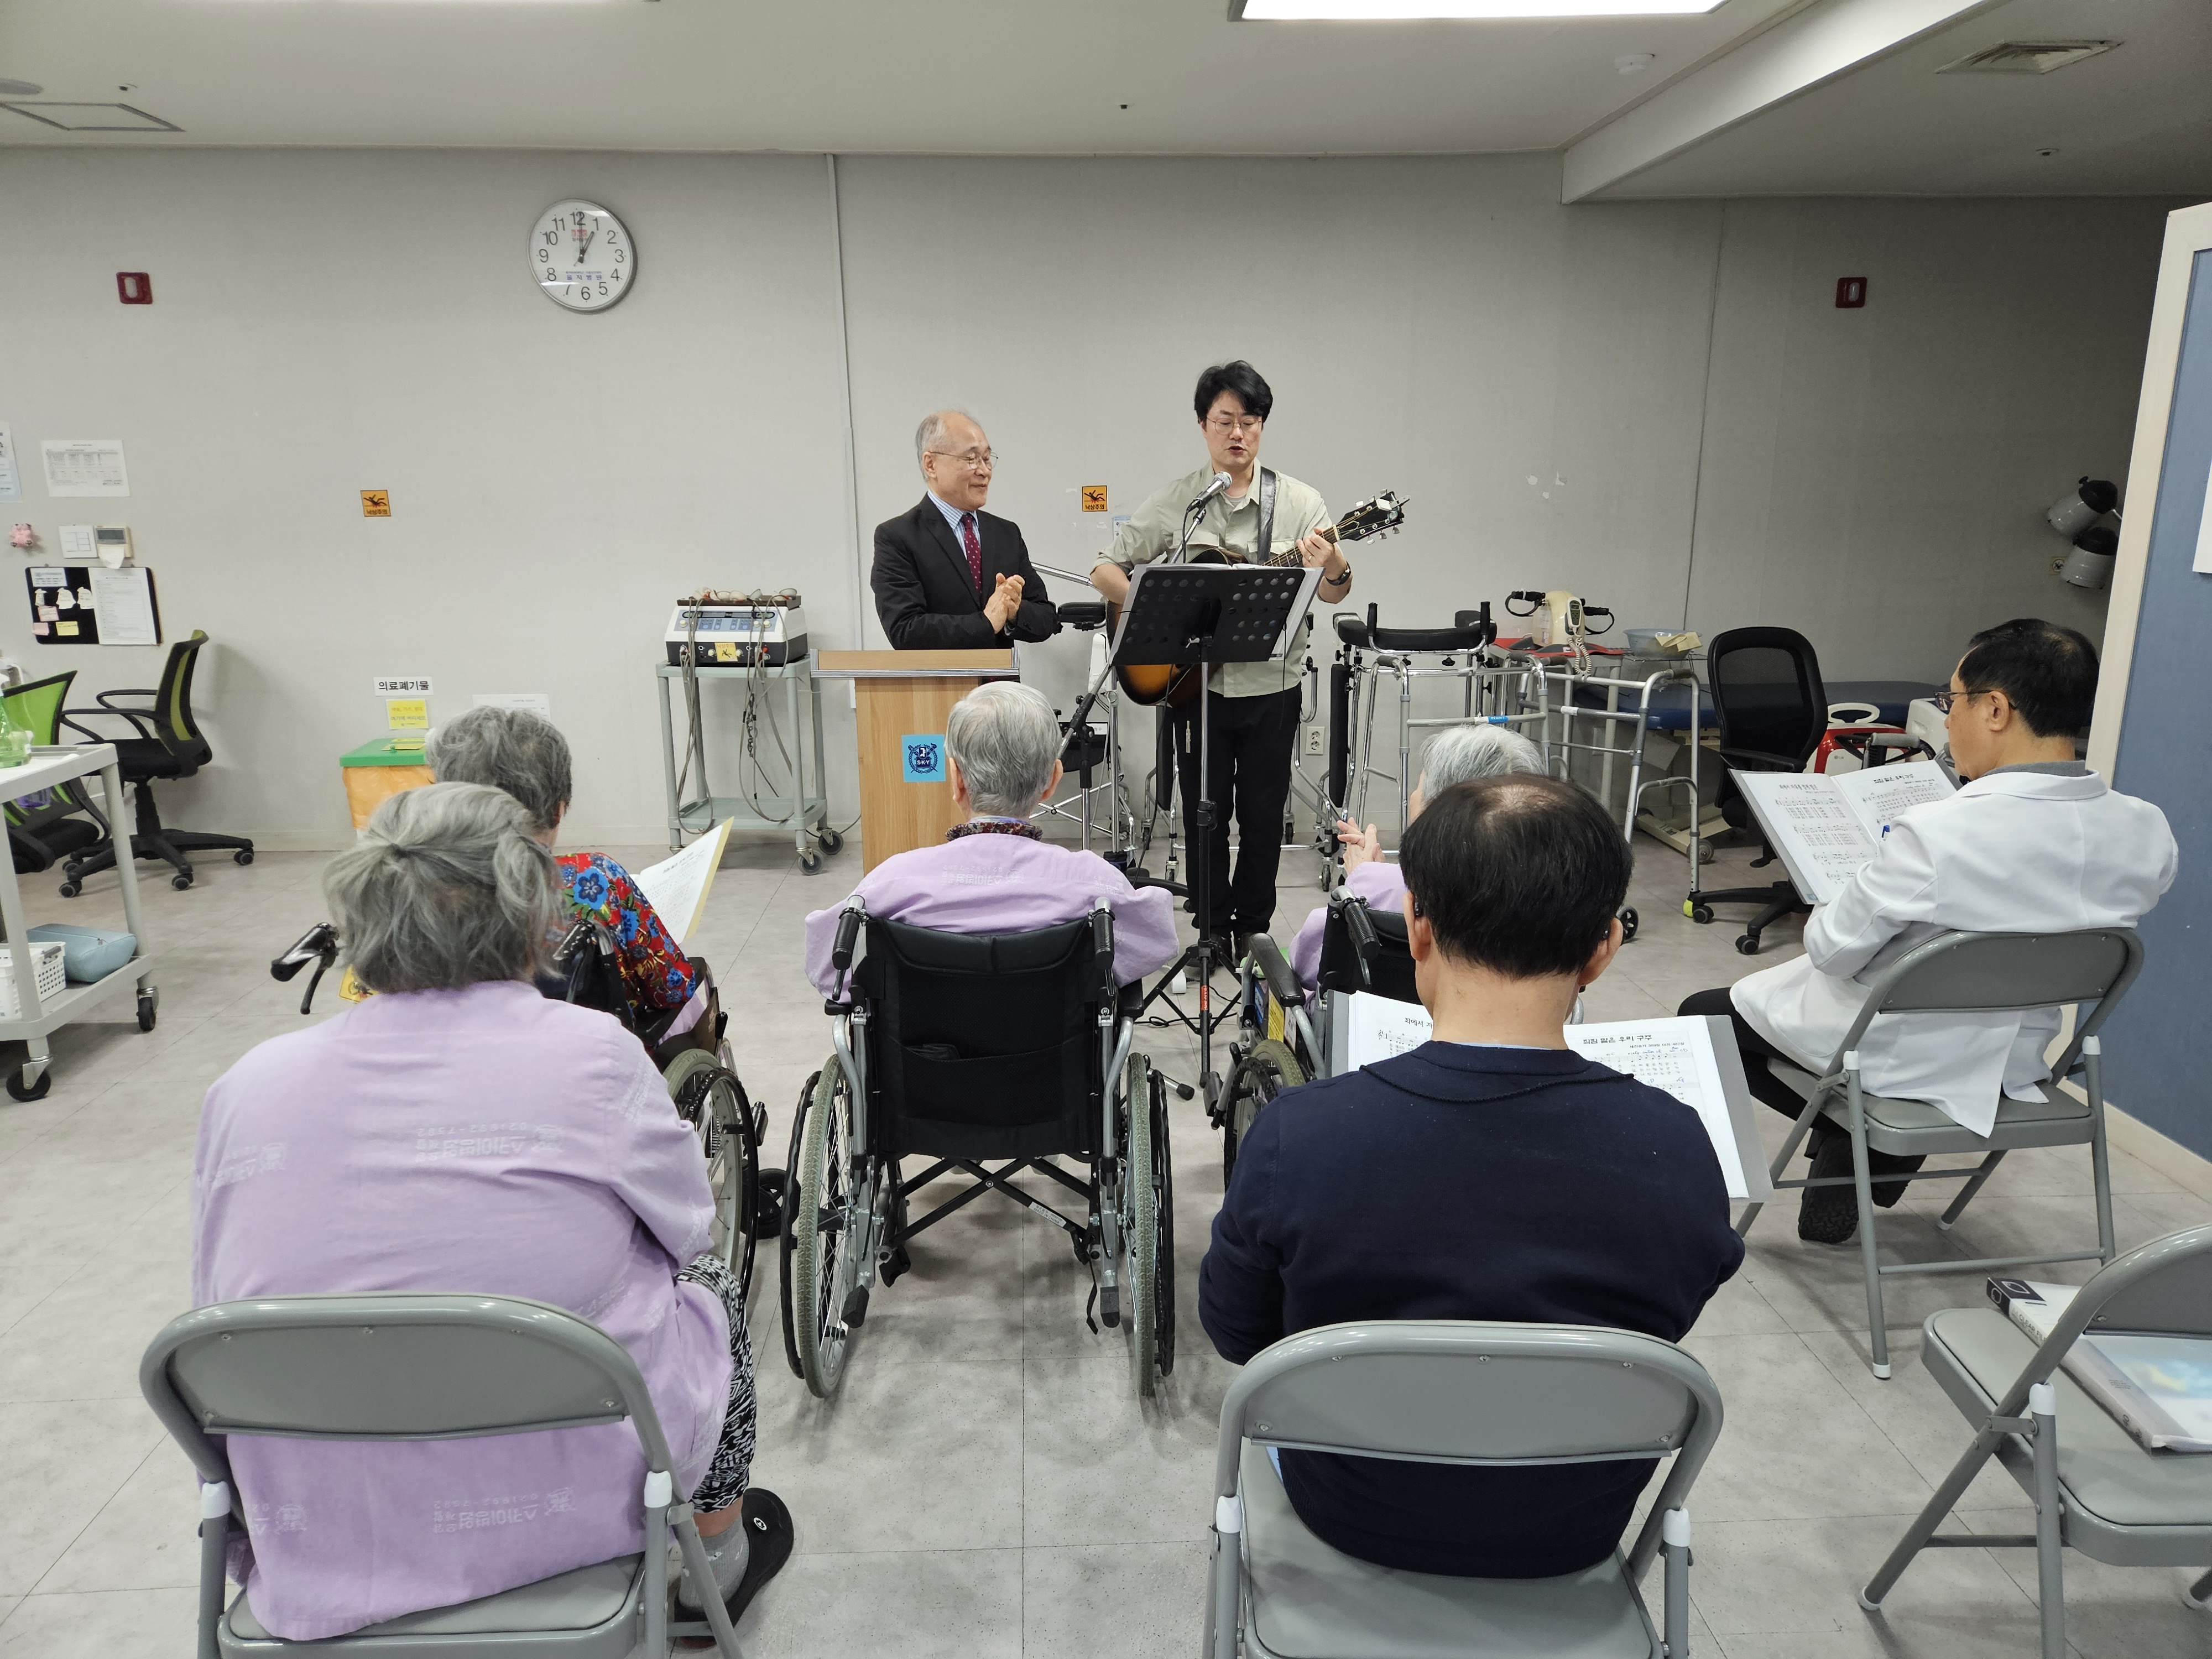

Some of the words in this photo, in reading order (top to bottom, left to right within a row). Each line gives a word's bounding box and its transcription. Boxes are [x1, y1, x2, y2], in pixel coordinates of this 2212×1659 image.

[552, 217, 565, 231] 11
[570, 211, 586, 226] 12
[592, 217, 599, 231] 1
[542, 231, 558, 246] 10
[607, 230, 617, 244] 2
[539, 249, 549, 263] 9
[614, 249, 624, 263] 3
[547, 268, 557, 281] 8
[610, 268, 620, 281] 4
[581, 286, 591, 300] 6
[598, 282, 608, 295] 5
[378, 681, 429, 691] 의료폐기물
[1404, 1018, 1423, 1027] 죄에서
[2019, 1314, 2036, 1332] CLEAR
